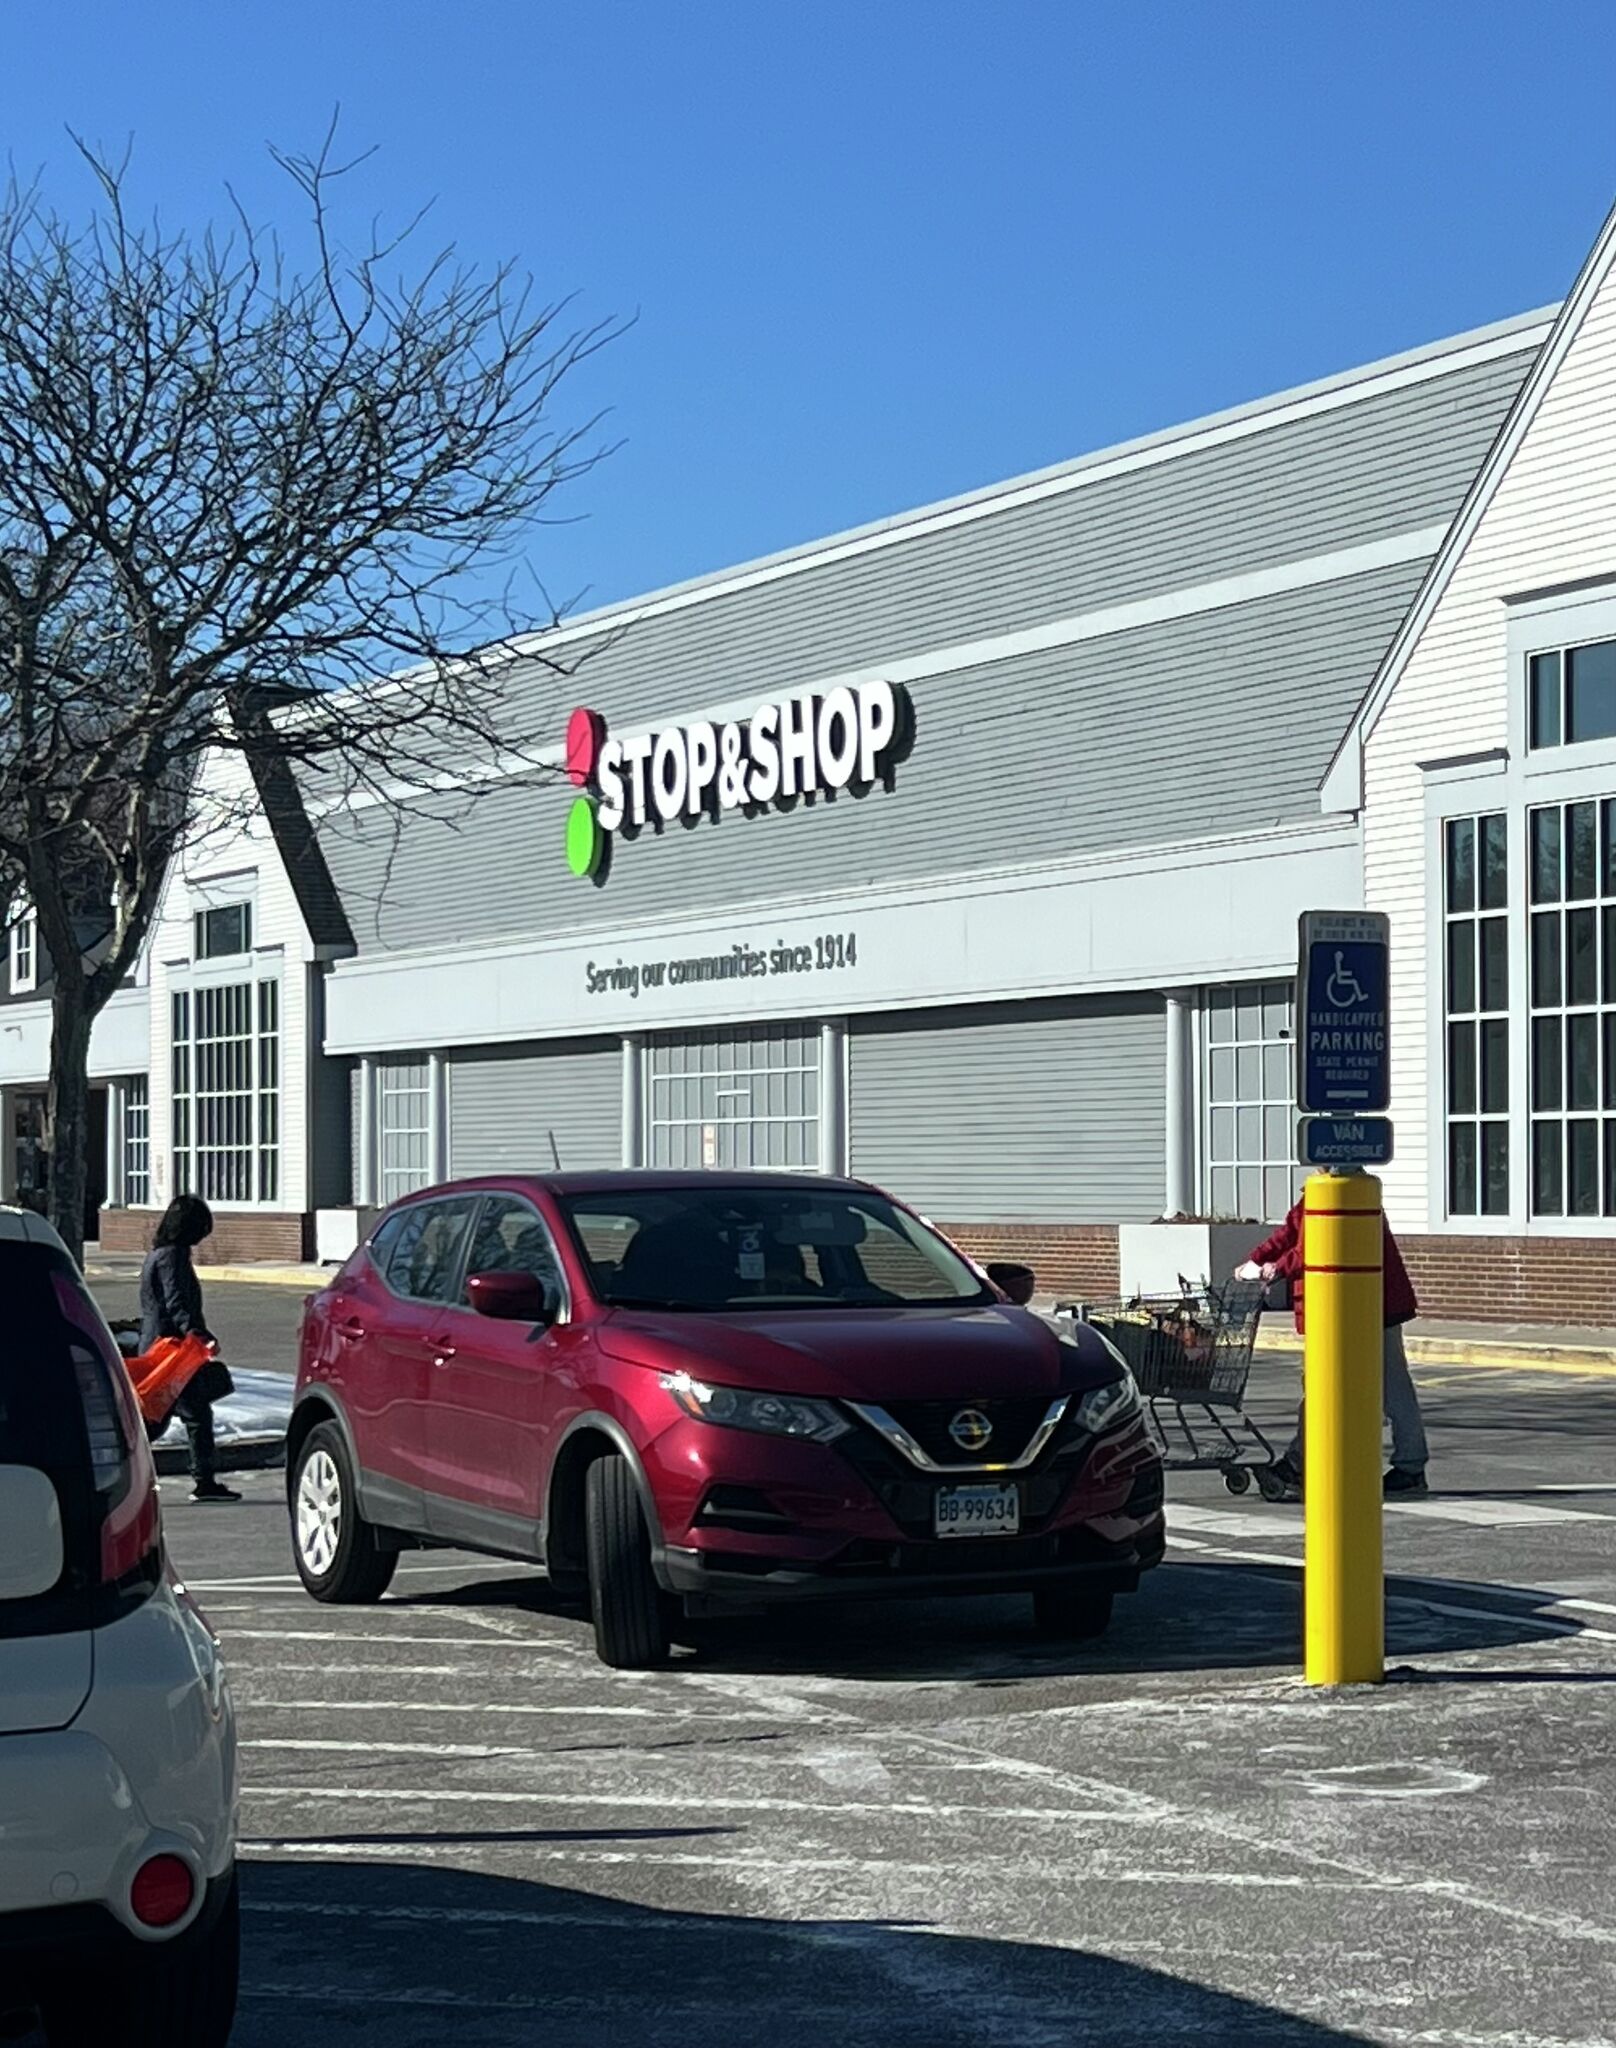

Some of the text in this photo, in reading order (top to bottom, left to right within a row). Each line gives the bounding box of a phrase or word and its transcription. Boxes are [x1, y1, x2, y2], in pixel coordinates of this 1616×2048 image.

[586, 930, 857, 998] Serving our communities since 1914
[1311, 1012, 1385, 1027] HANDICAPPED
[1311, 1031, 1385, 1051] PARKING
[1332, 1123, 1365, 1141] VAN
[1314, 1143, 1385, 1158] ACCESSIBLE
